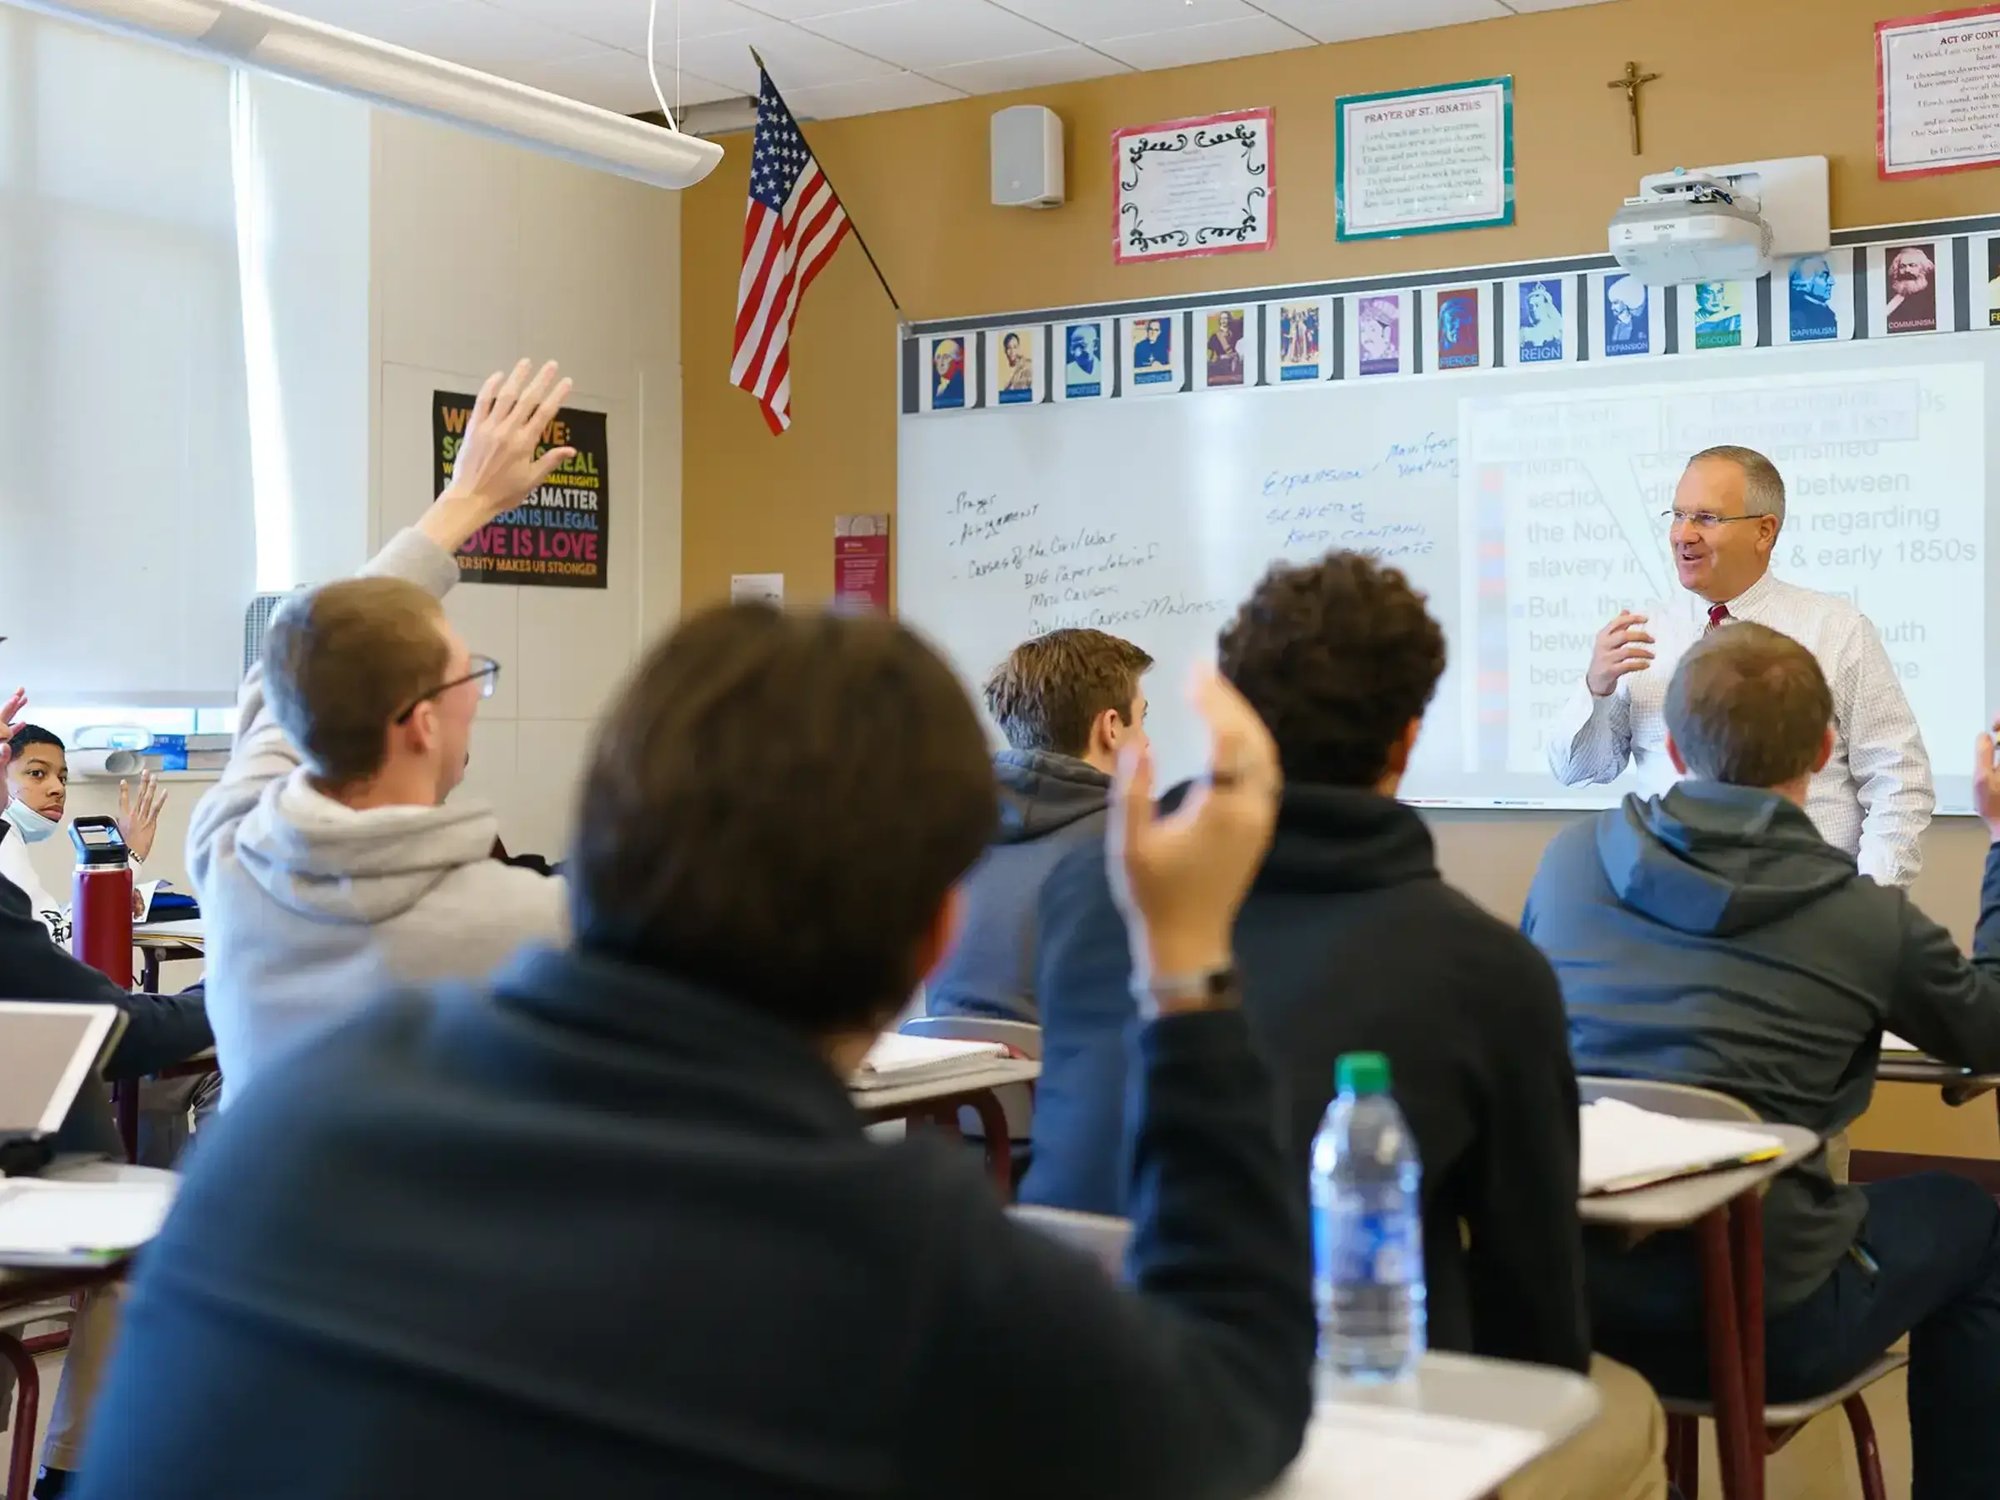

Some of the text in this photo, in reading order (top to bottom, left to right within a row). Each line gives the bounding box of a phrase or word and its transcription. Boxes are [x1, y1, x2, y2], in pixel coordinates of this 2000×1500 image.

[1940, 36, 1959, 45] ACT
[1961, 33, 1974, 42] OF
[1364, 100, 1482, 124] PRAYER OF ST. IGNATIUS
[1653, 223, 1676, 232] EPSON
[1790, 326, 1837, 338] CAPITALISM
[1888, 317, 1936, 330] COMMUNISM
[1521, 346, 1560, 360] REIGN
[1606, 341, 1648, 353] EXPANSION
[556, 451, 599, 475] EAL
[1796, 472, 1911, 497] between
[541, 487, 599, 511] MATTER
[529, 509, 541, 527] IS
[543, 510, 599, 531] ILLEGAL
[1527, 520, 1564, 545] the
[1573, 520, 1624, 544] Nor
[1811, 505, 1941, 536] regarding
[511, 527, 533, 557] IS
[539, 529, 599, 562] LOVE
[496, 557, 531, 573] MAKES
[532, 560, 546, 575] US
[547, 561, 598, 576] STRONGER
[1527, 555, 1614, 582] slavery
[1790, 545, 1807, 569] &
[1817, 542, 1883, 571] early
[1896, 537, 1978, 564] 1850s
